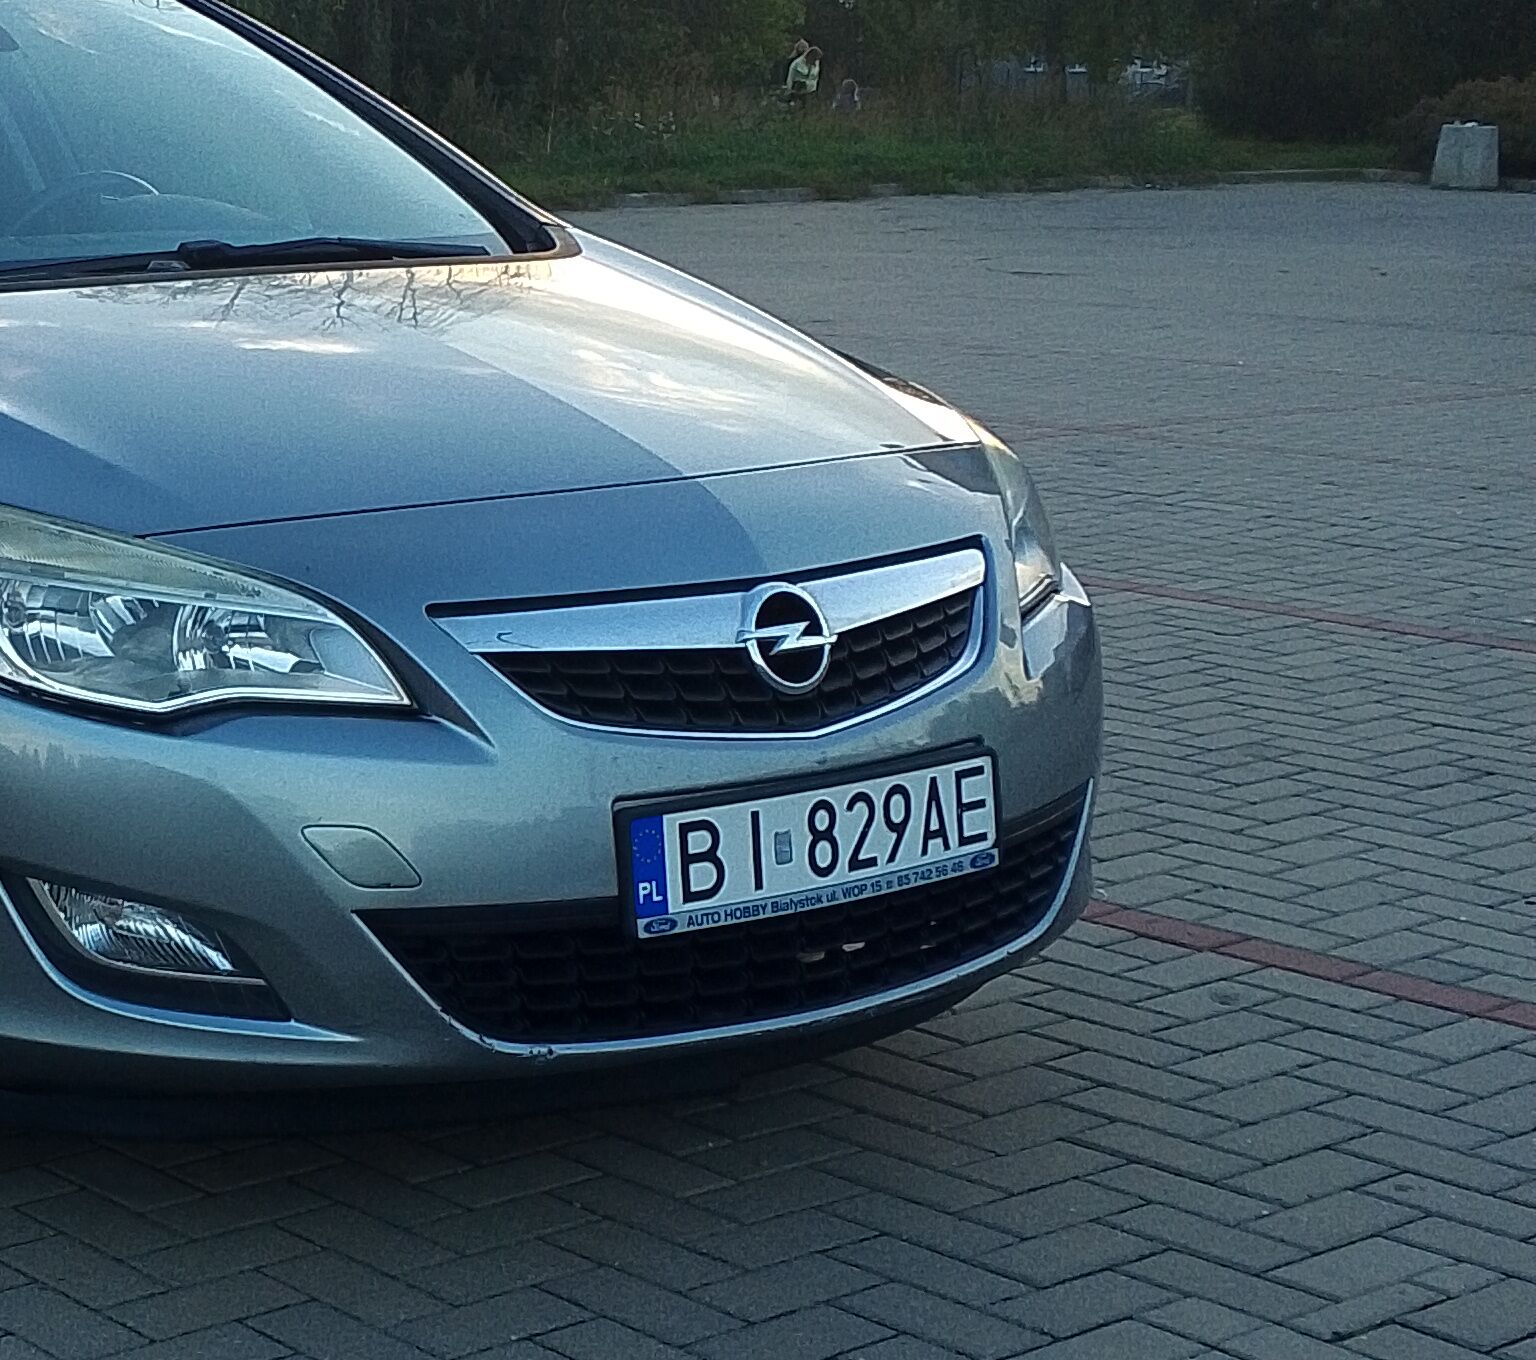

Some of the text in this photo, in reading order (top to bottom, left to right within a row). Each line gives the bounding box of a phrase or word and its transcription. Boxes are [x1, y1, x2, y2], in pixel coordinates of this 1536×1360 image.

[678, 765, 990, 905] BI 829AE
[638, 881, 663, 904] PL
[686, 910, 721, 928] AUTO
[724, 903, 768, 923] HOBBY
[771, 890, 824, 914] Białystok
[842, 883, 868, 900] WOP
[870, 880, 883, 894] 15
[913, 868, 933, 884] 742
